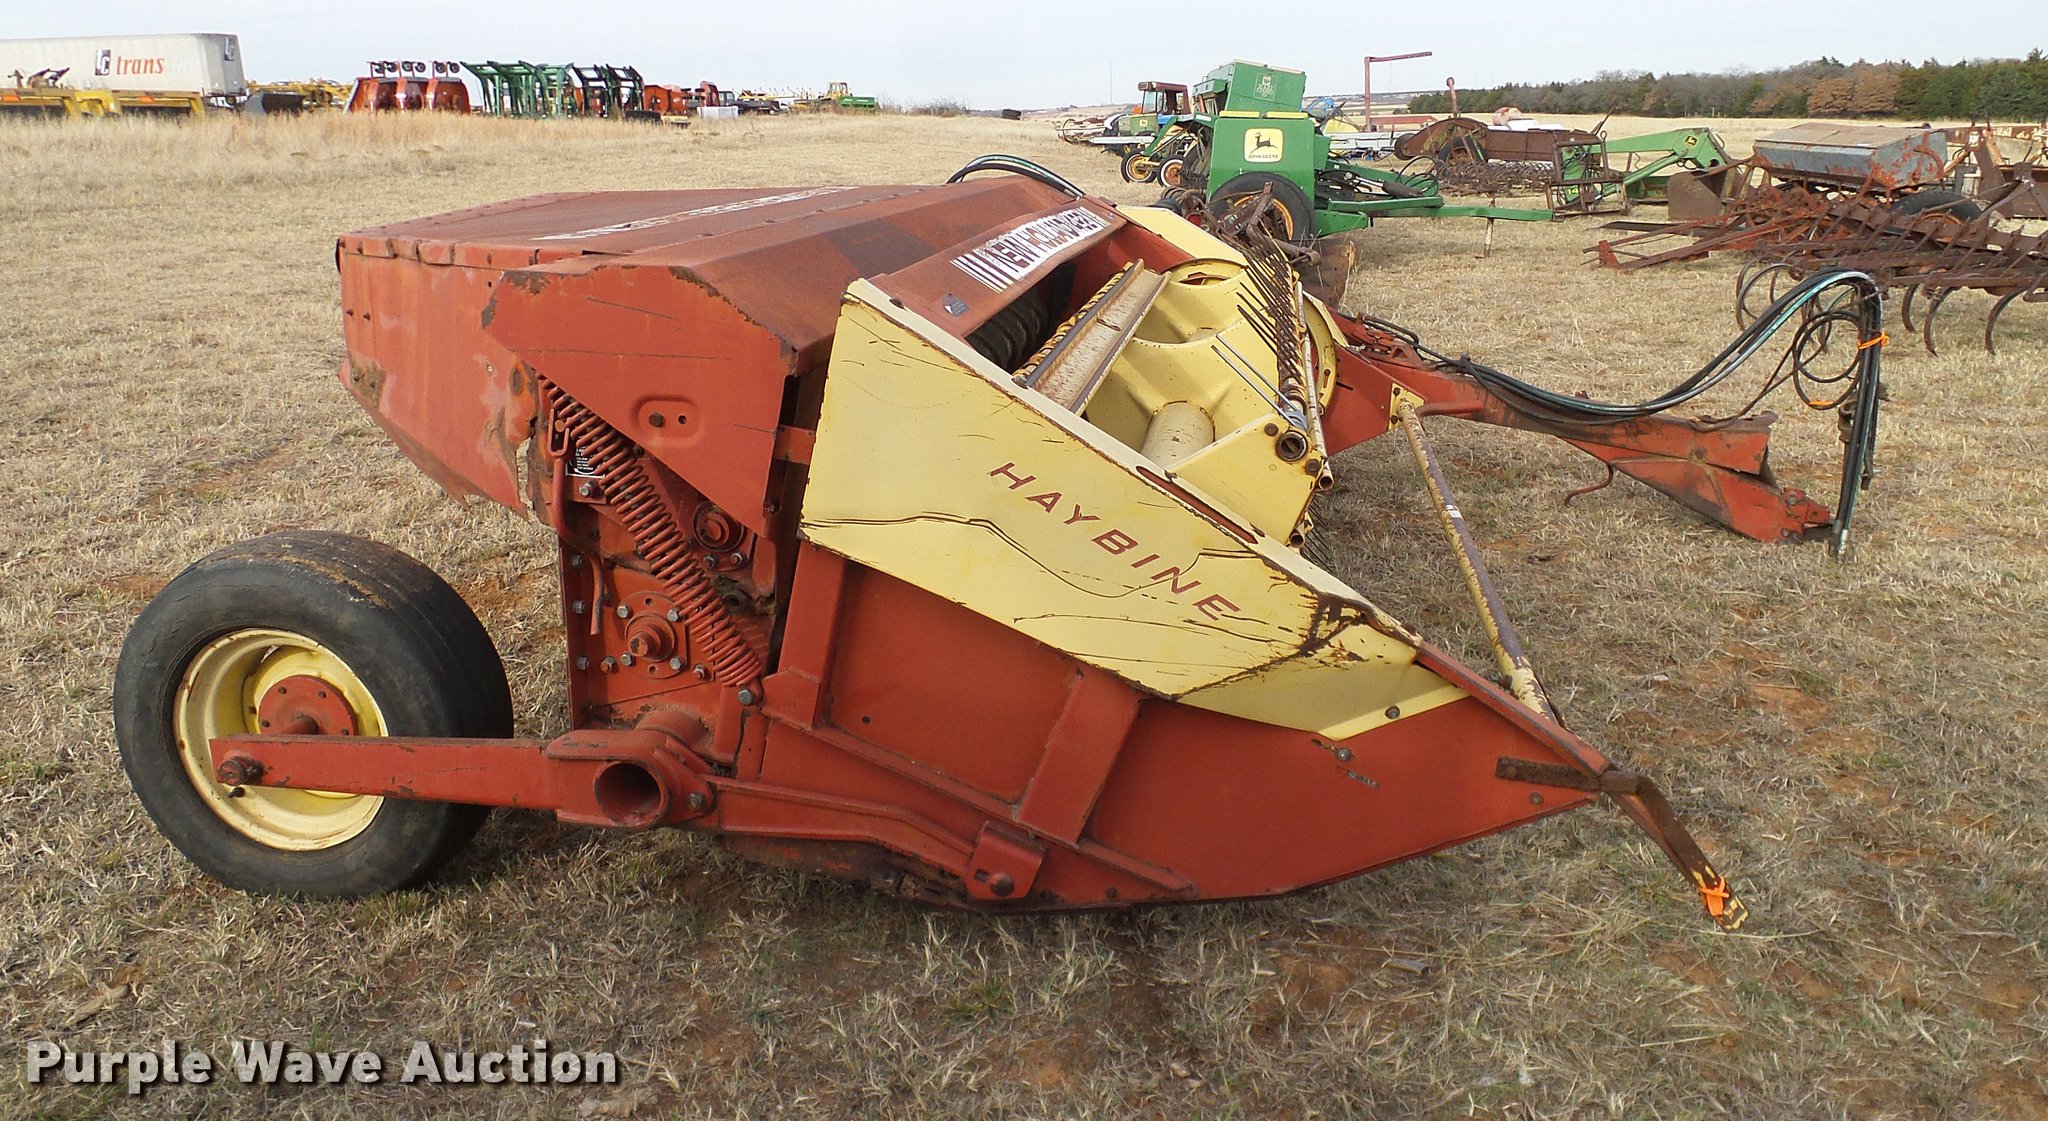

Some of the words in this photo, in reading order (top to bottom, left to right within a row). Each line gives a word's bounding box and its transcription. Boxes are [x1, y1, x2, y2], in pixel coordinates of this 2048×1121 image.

[117, 56, 164, 75] trans
[985, 237, 1040, 273] NEW
[989, 462, 1241, 621] HAYBINE
